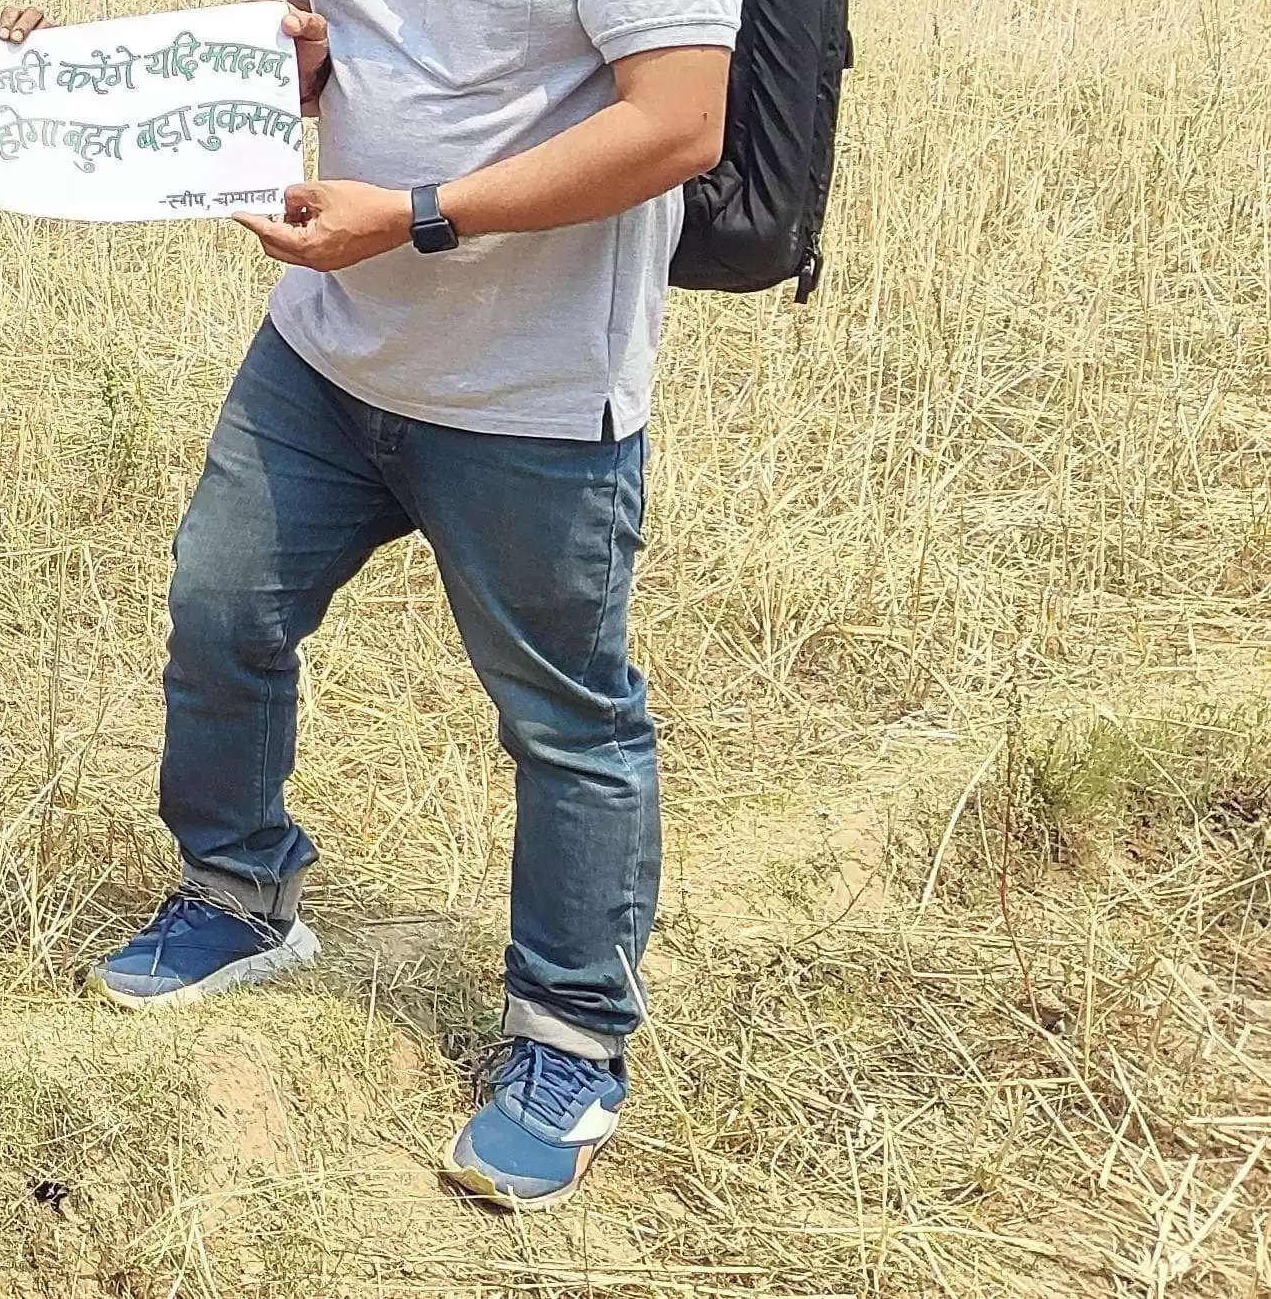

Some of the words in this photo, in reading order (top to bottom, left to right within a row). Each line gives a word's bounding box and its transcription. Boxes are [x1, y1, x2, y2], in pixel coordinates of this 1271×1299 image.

[56, 45, 141, 94] करेंगे
[144, 31, 201, 81] यदि
[199, 42, 292, 87] मतदान,
[63, 121, 130, 174] बहुत
[137, 106, 191, 153] बड़ा
